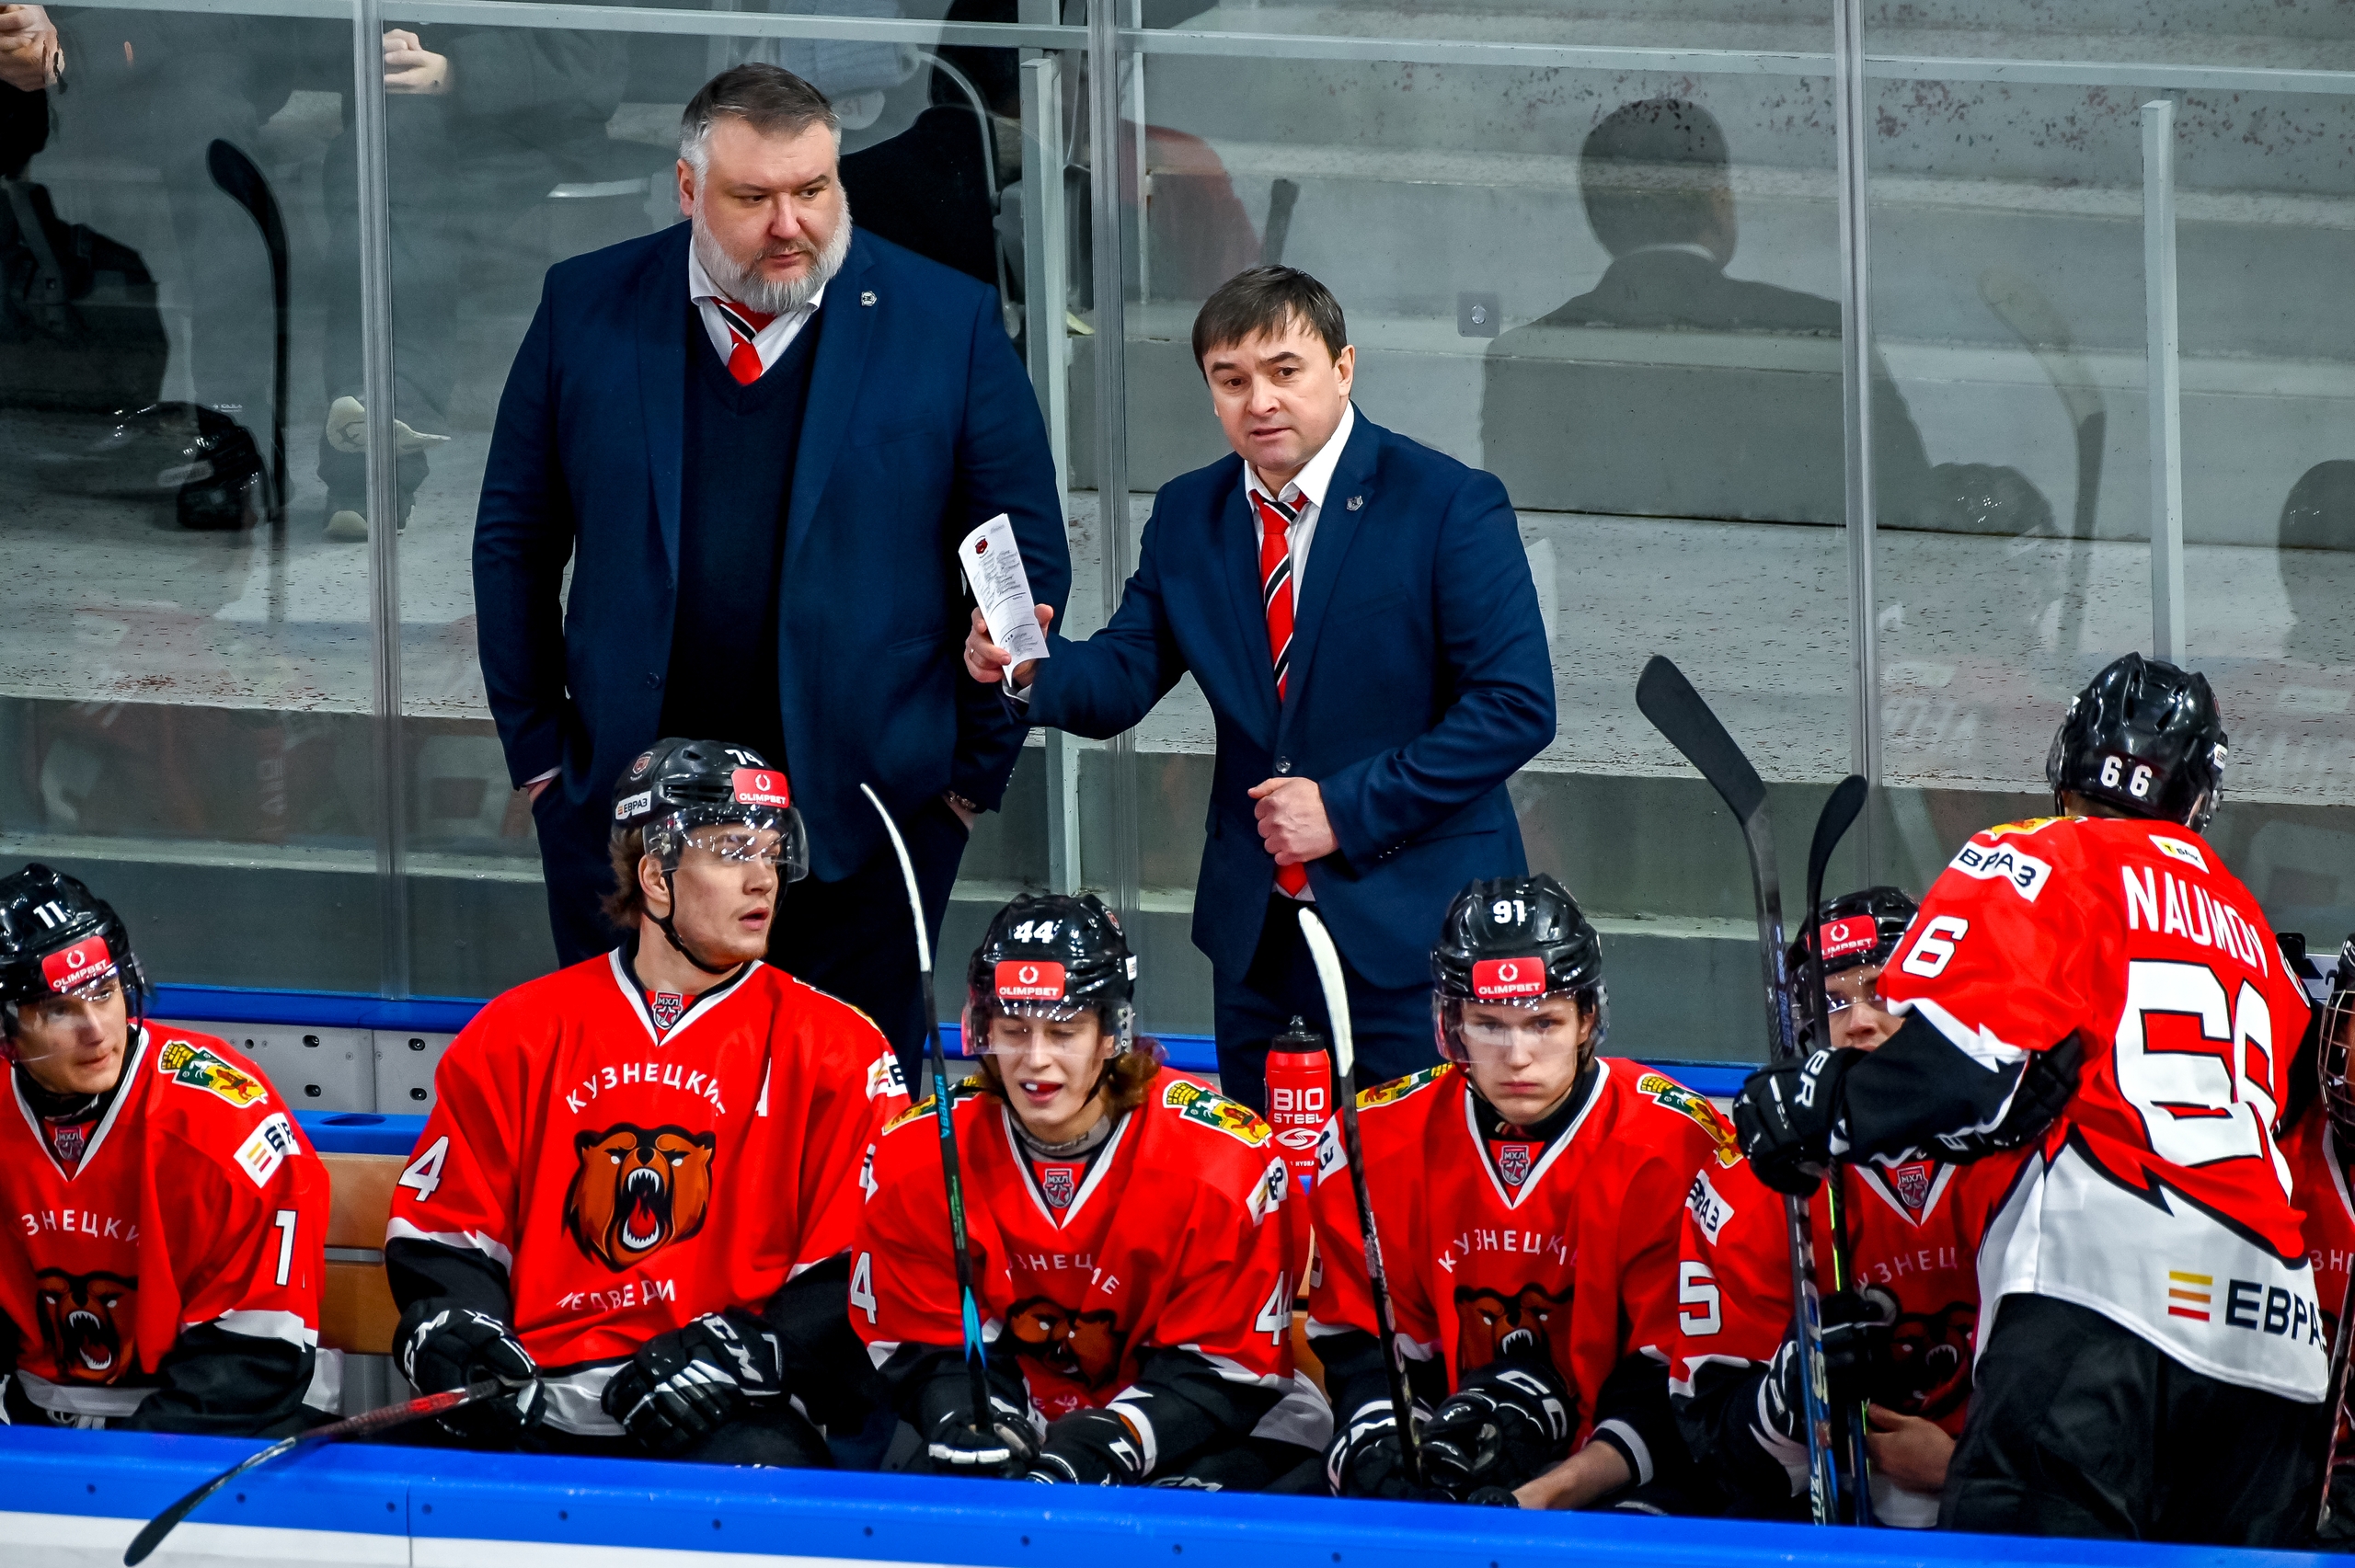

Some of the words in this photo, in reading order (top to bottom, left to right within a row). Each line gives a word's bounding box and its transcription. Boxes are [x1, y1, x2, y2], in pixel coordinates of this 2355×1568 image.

[2100, 755, 2153, 797] 66
[623, 797, 648, 814] ЕВРАЗ
[740, 793, 787, 805] OLIMPBET
[1959, 848, 2037, 887] ВРАЗ
[33, 901, 67, 929] 11
[1493, 900, 1525, 924] 91
[1013, 920, 1054, 944] 44
[1821, 938, 1872, 955] LIMPBET
[1901, 915, 1969, 979] 6
[52, 959, 107, 988] OLIMPBET
[999, 987, 1059, 996] OLIMPBET
[1478, 982, 1541, 994] OLIMPBET
[658, 997, 679, 1007] МХЛ
[1273, 1087, 1324, 1111] BIO
[1274, 1113, 1324, 1124] STEEL
[1504, 1151, 1525, 1160] МХЛ
[1048, 1175, 1069, 1185] МХЛ
[1901, 1173, 1923, 1184] МХЛ
[1688, 1177, 1720, 1232] ВРАЗ
[275, 1209, 305, 1288] 1
[1679, 1261, 1721, 1335] 5
[2225, 1278, 2328, 1356] ЕВРА
